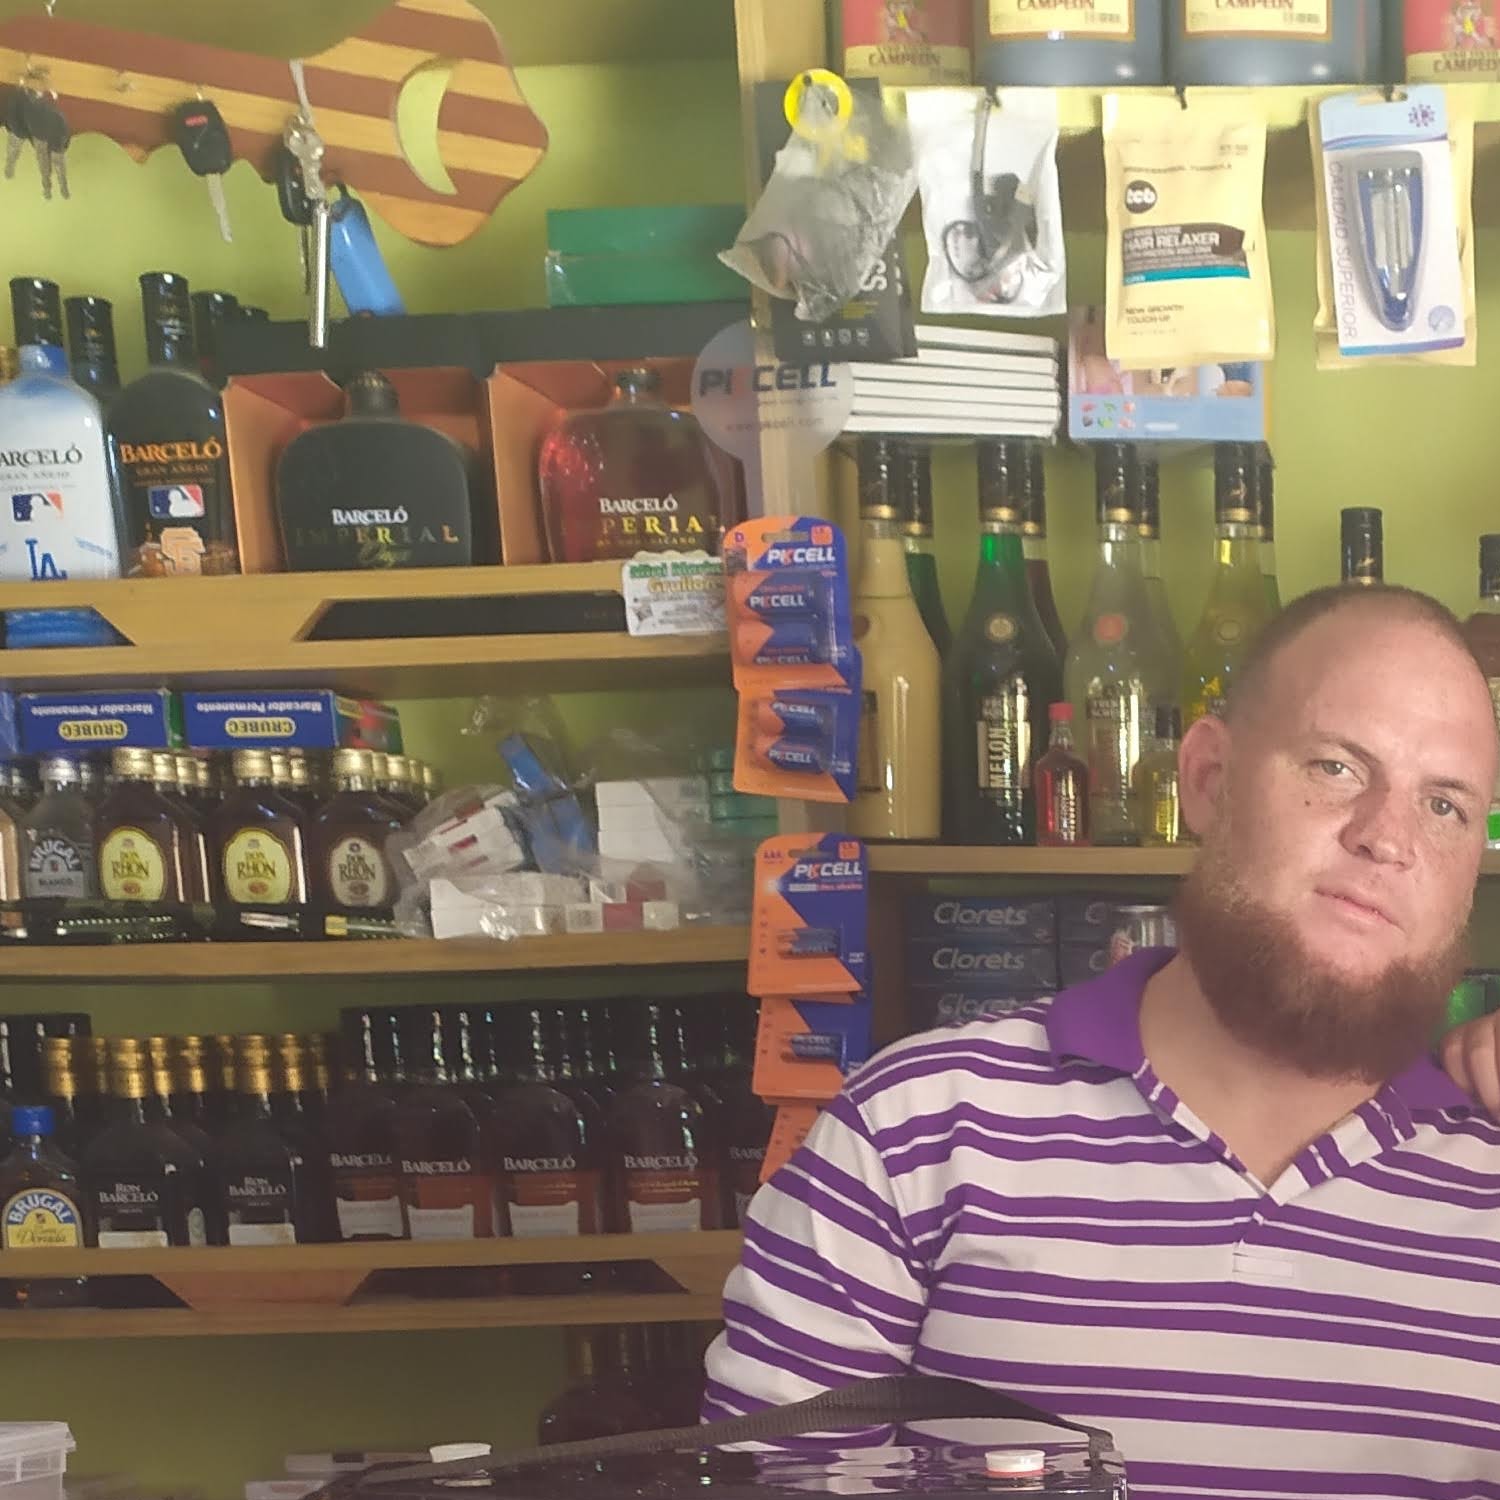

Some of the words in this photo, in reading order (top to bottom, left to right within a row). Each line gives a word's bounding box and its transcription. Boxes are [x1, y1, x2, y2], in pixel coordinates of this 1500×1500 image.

[1329, 161, 1349, 241] CALIDAD
[1155, 231, 1220, 249] RELAXER
[1336, 243, 1357, 338] SUPERIOR
[119, 436, 222, 463] BARCELÓ
[600, 494, 678, 513] BARCELÓ
[331, 506, 409, 525] BARCELÓ
[99, 703, 154, 715] Marcador
[267, 701, 323, 713] Marcador
[237, 861, 276, 880] RHON
[933, 902, 1028, 926] Clorets
[932, 948, 1025, 969] Clorets
[402, 1158, 471, 1173] BARCELÓ
[504, 1154, 576, 1171] BARCELÓ
[624, 1154, 698, 1171] BARCELÓ
[8, 1194, 67, 1223] BRUGAL
